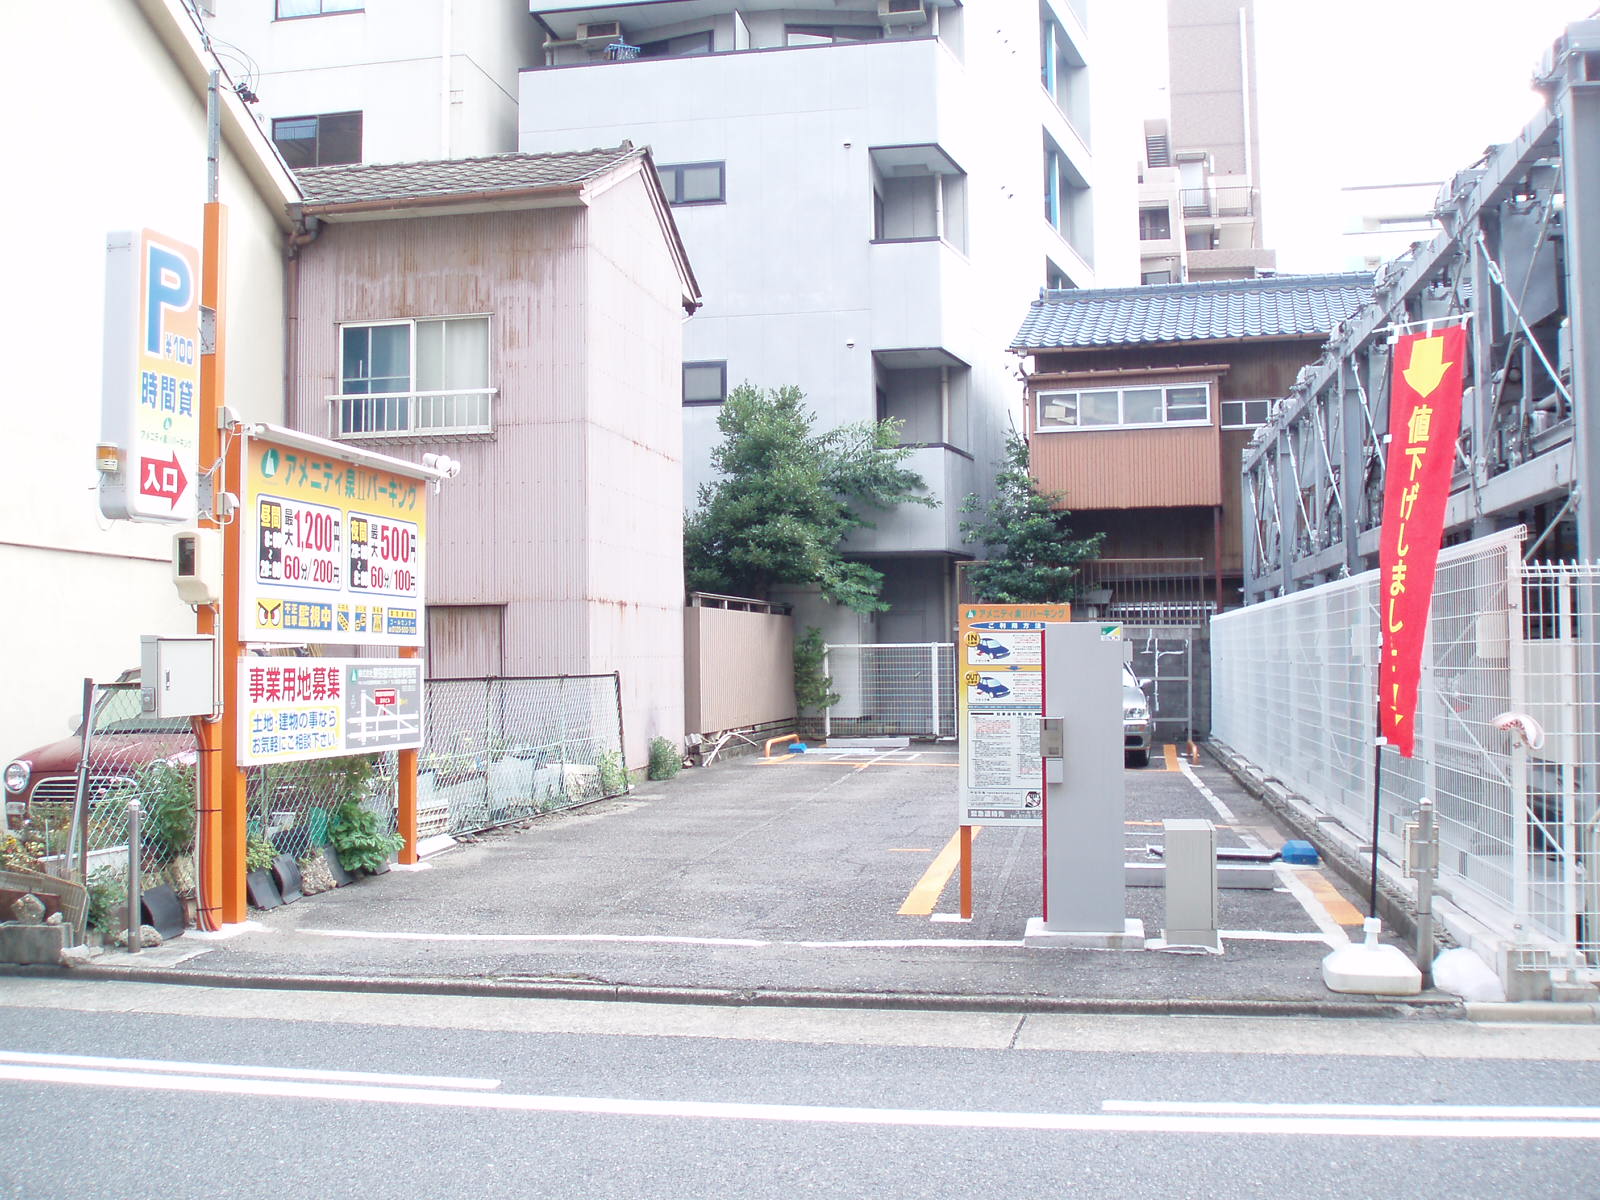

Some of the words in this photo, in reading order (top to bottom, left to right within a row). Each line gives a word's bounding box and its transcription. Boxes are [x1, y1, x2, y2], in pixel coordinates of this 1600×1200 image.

[146, 244, 192, 355] P
[141, 371, 193, 417] 時間貸
[143, 463, 179, 494] 入口
[249, 667, 340, 703] 事業用地募集
[966, 673, 979, 681] OUT
